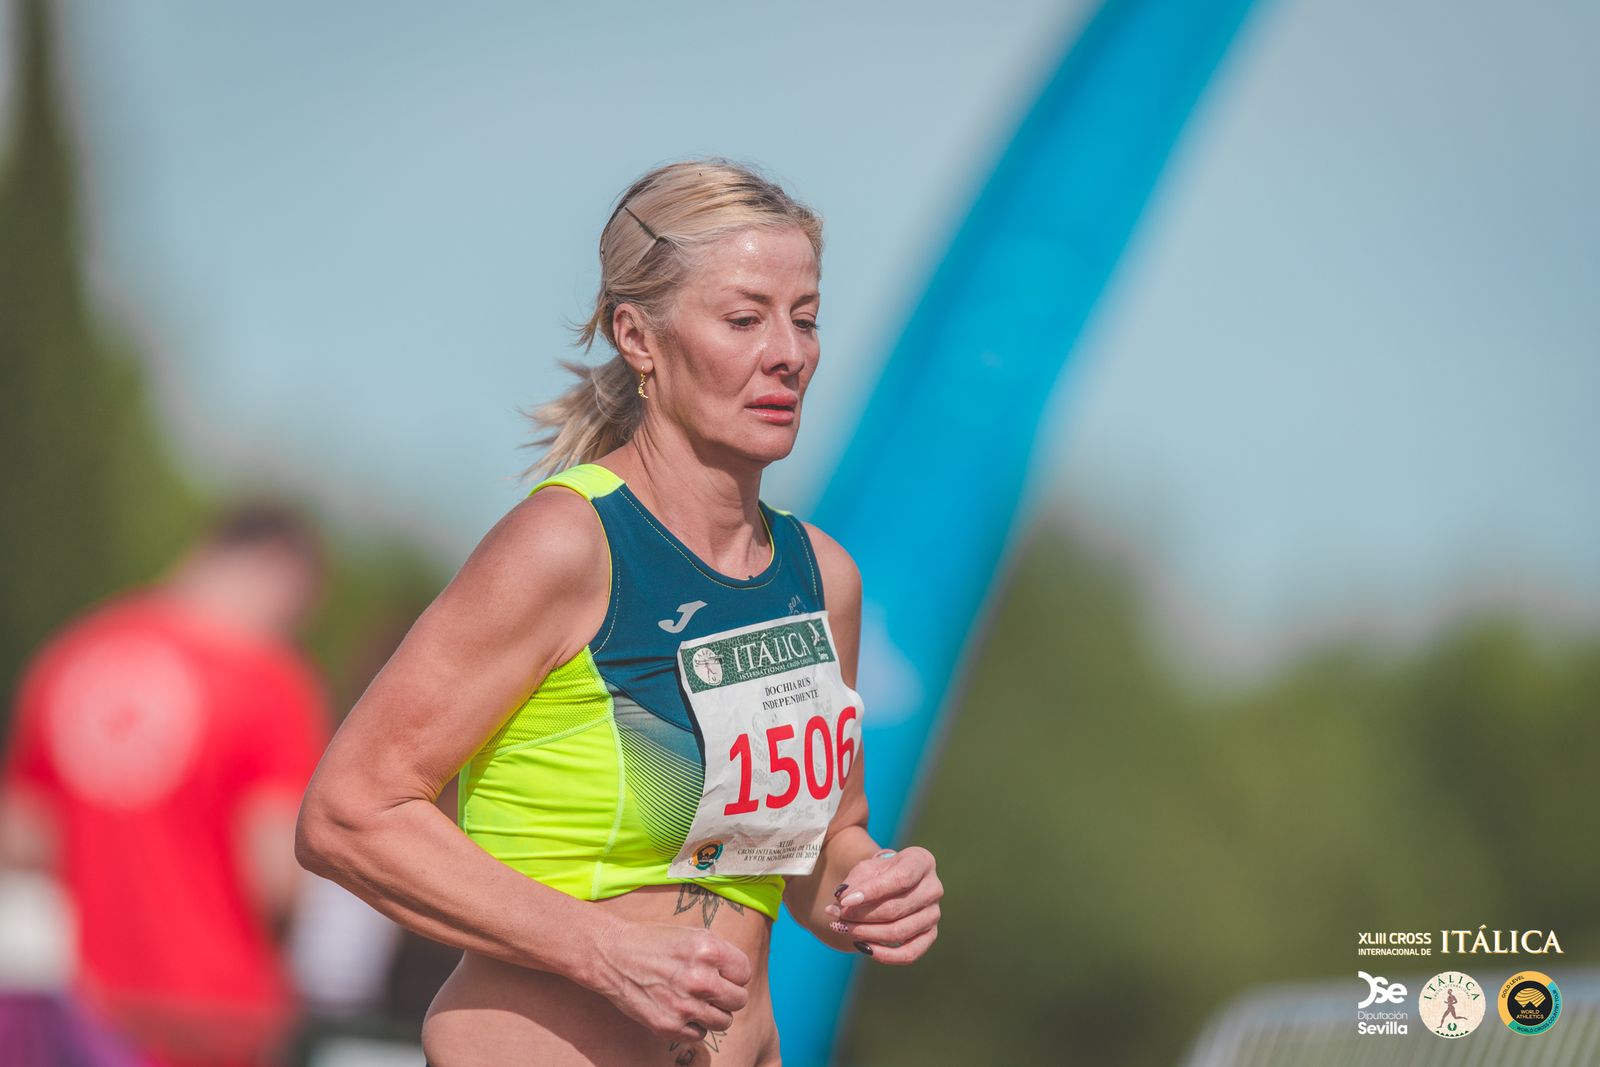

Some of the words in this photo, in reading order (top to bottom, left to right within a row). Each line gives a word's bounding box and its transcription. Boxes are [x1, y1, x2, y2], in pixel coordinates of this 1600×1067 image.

[731, 633, 811, 673] ITÁLICA
[762, 689, 819, 711] INDEPENDIENTE
[764, 681, 798, 697] DOCHIA
[723, 706, 857, 816] 1506
[737, 848, 756, 856] CROSS
